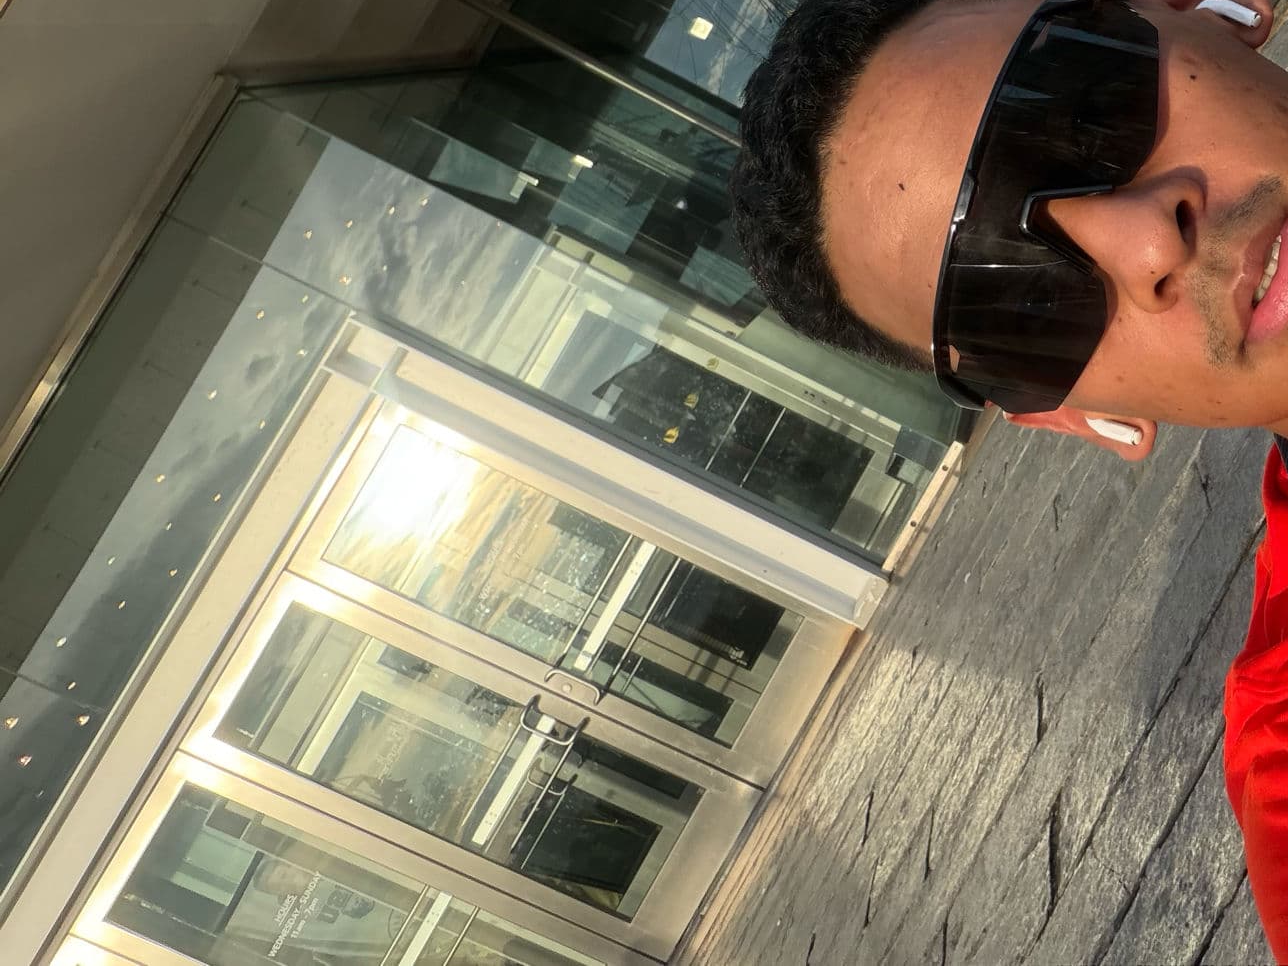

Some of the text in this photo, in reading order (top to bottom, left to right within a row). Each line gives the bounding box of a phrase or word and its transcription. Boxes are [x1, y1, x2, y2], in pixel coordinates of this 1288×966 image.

[268, 908, 300, 957] WEDNESDAY
[299, 871, 321, 904] SUNDAY
[274, 894, 295, 922] HOURS
